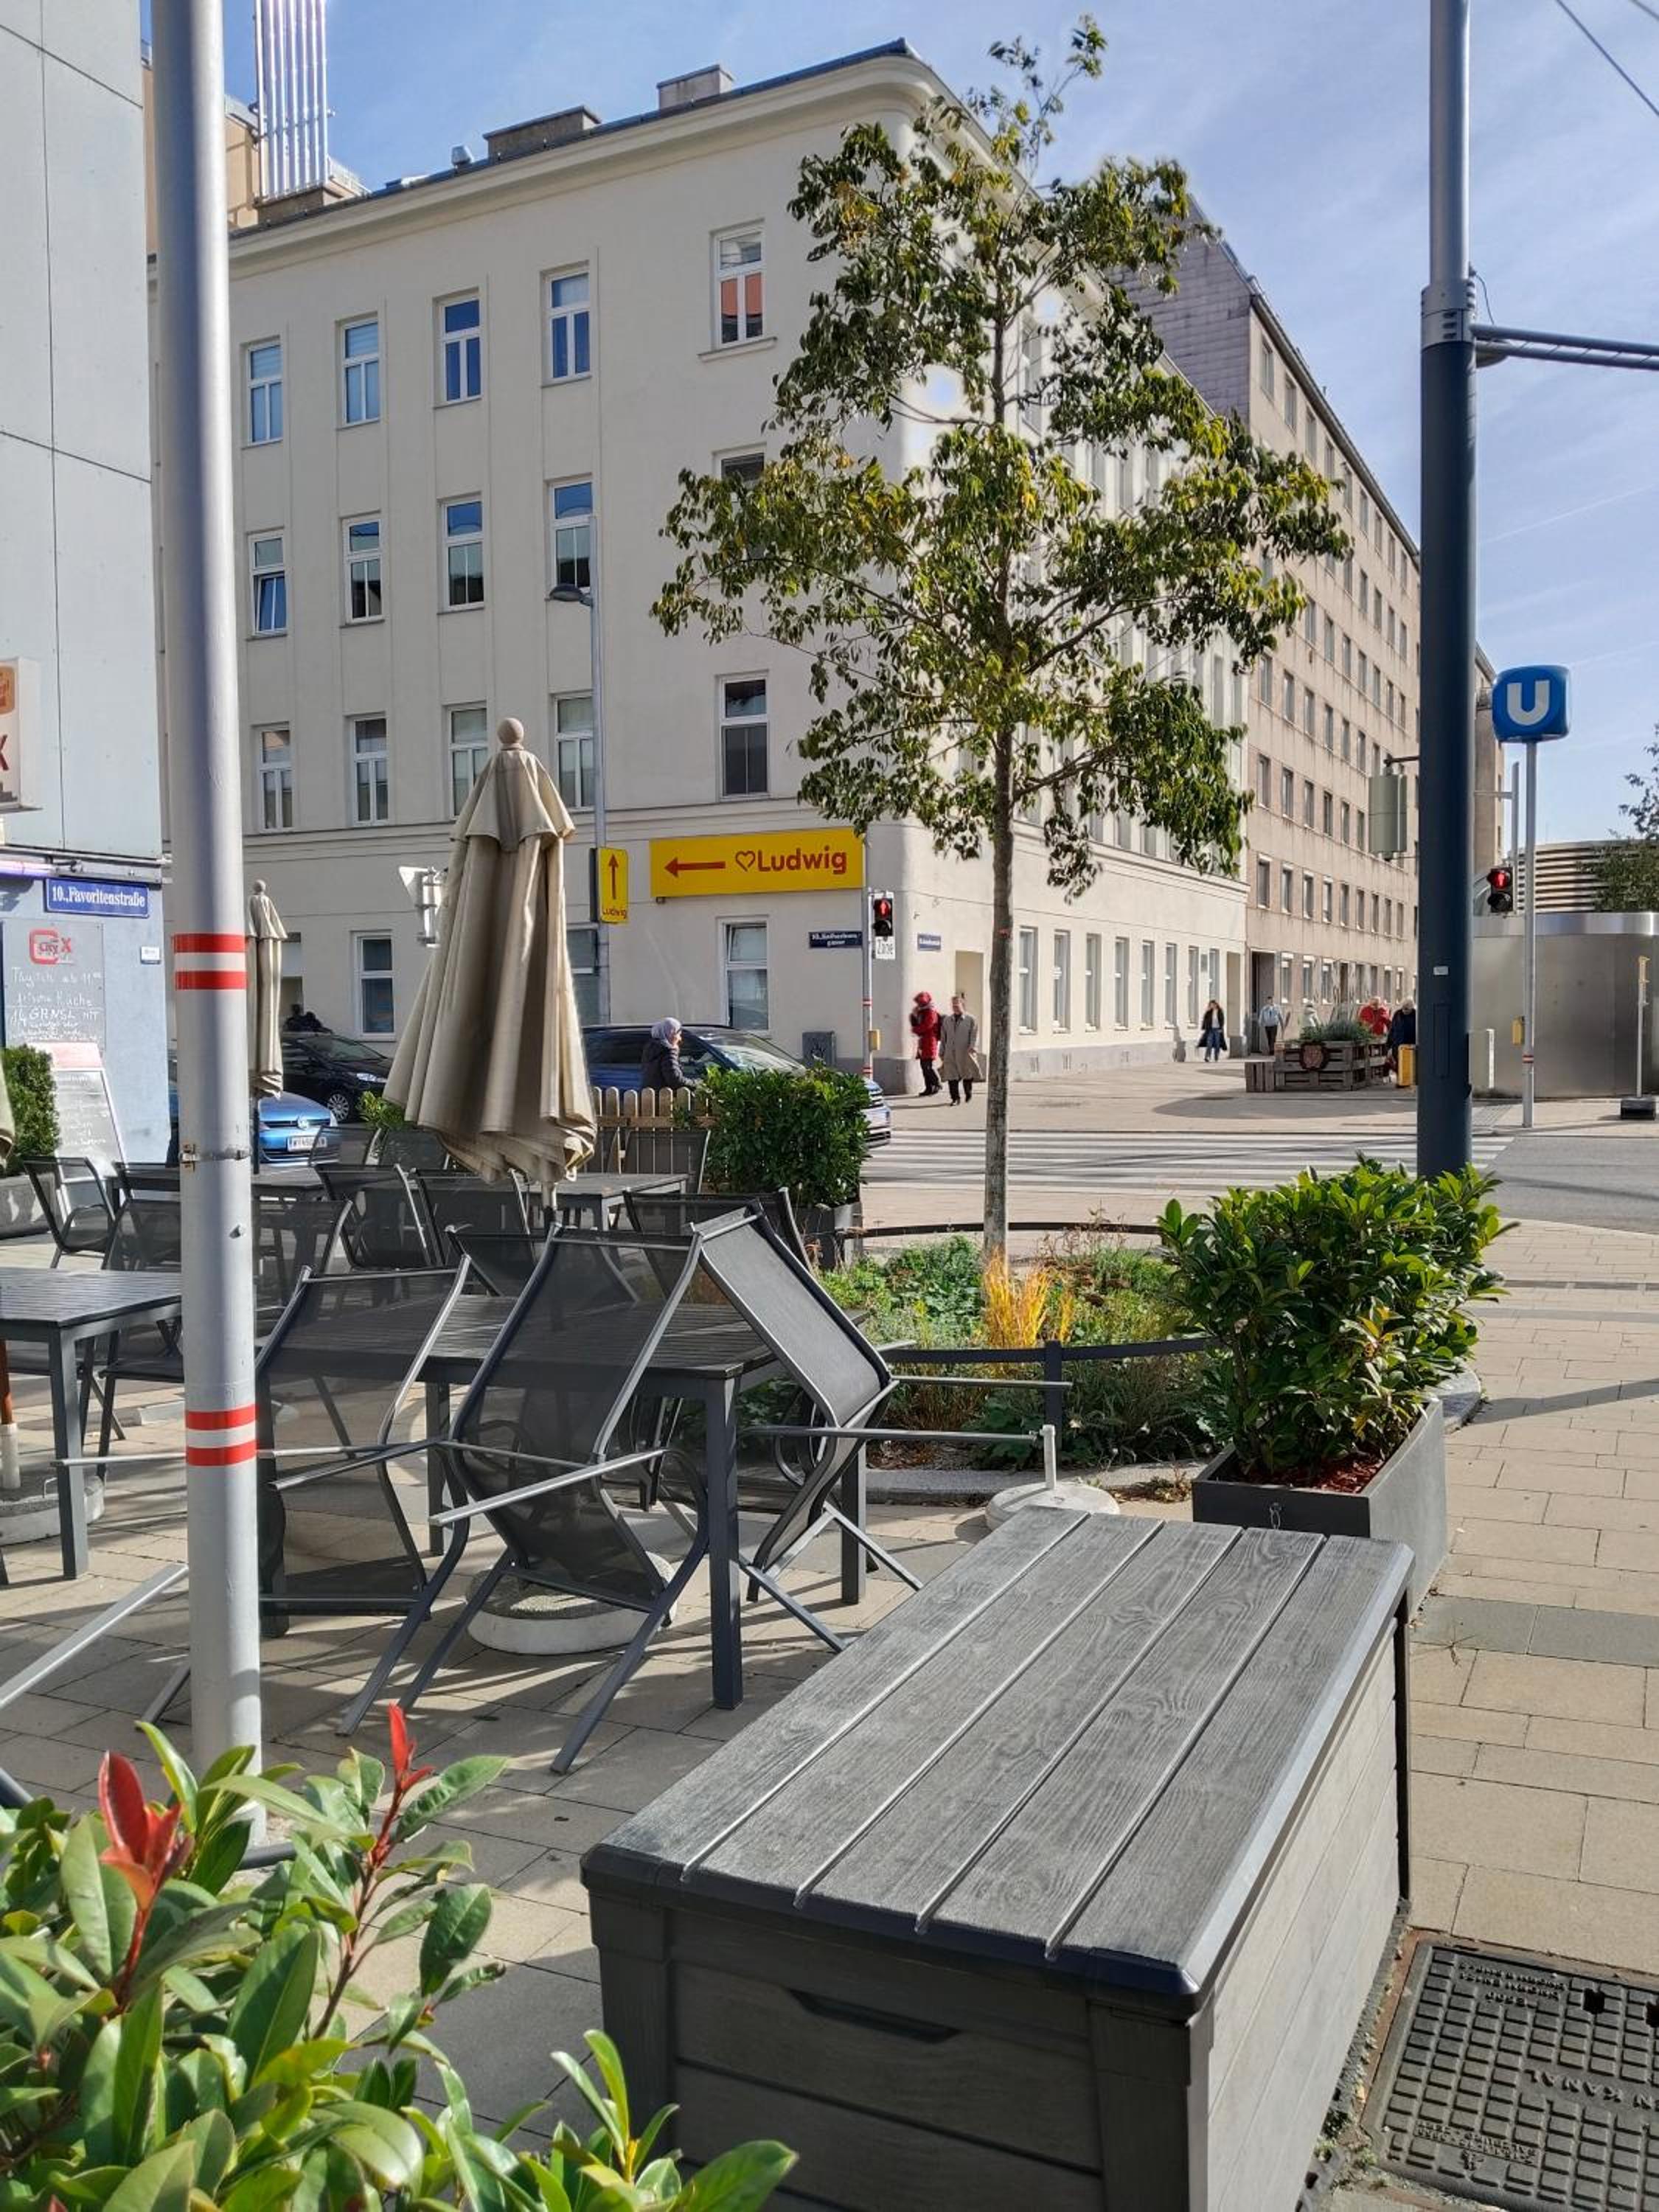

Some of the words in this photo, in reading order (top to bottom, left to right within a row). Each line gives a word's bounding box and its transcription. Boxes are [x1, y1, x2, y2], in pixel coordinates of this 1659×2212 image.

[1506, 680, 1550, 726] U
[757, 846, 847, 874] Ludwig
[1523, 2068, 1622, 2103] KANAL
